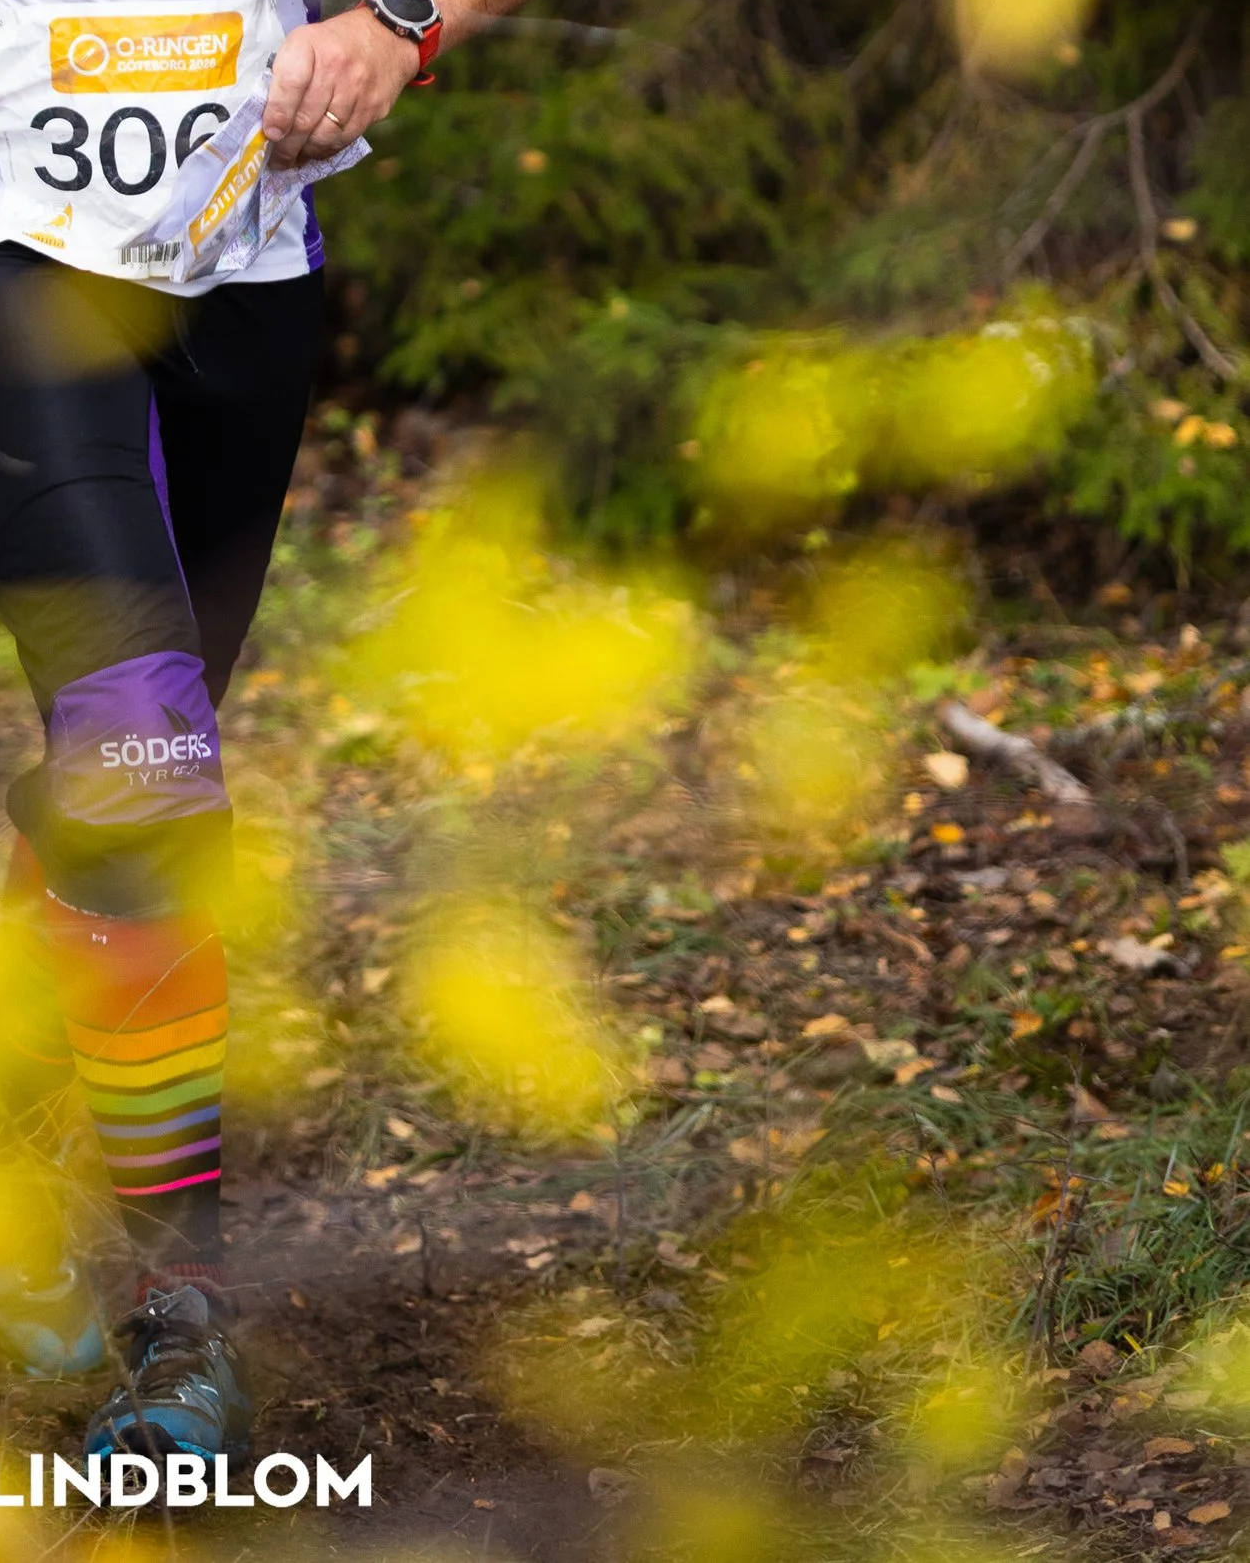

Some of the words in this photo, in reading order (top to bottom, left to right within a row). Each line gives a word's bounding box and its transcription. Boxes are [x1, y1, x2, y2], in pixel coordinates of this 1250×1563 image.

[116, 34, 229, 57] O-RINGEN
[117, 58, 187, 72] GÖTEBORG
[189, 58, 216, 70] 2026
[101, 733, 212, 768] SÖDERS
